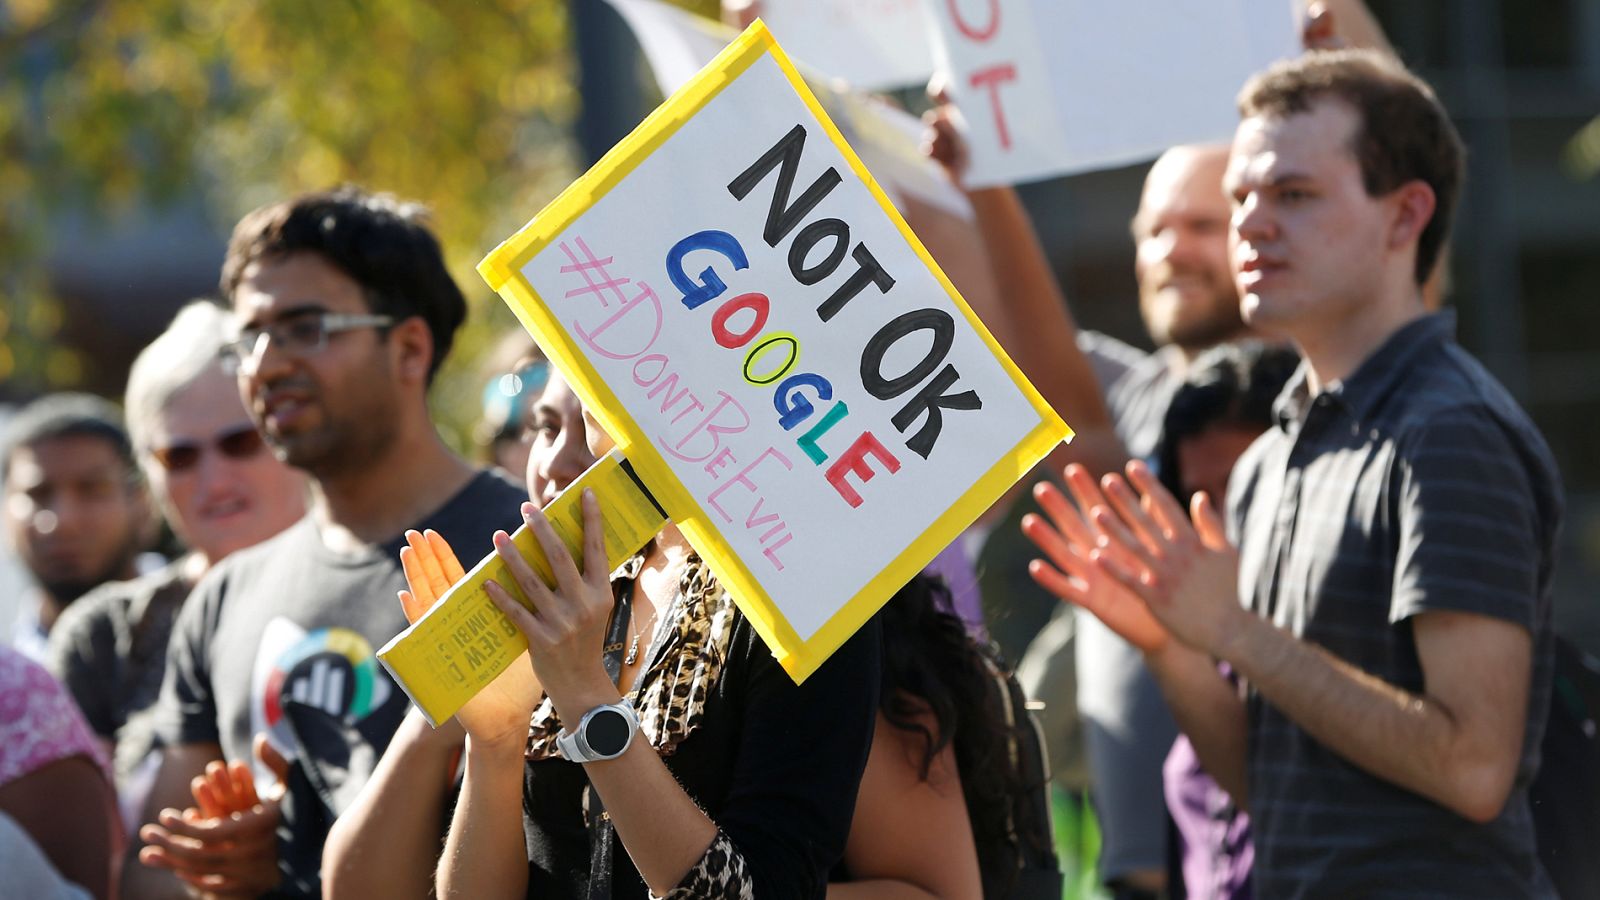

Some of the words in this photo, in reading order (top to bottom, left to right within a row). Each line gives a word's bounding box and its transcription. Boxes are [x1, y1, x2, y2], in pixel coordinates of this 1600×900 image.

[666, 230, 901, 508] GOOGLE
[728, 124, 896, 322] NOT
[860, 308, 982, 459] OK
[461, 615, 519, 672] BREW
